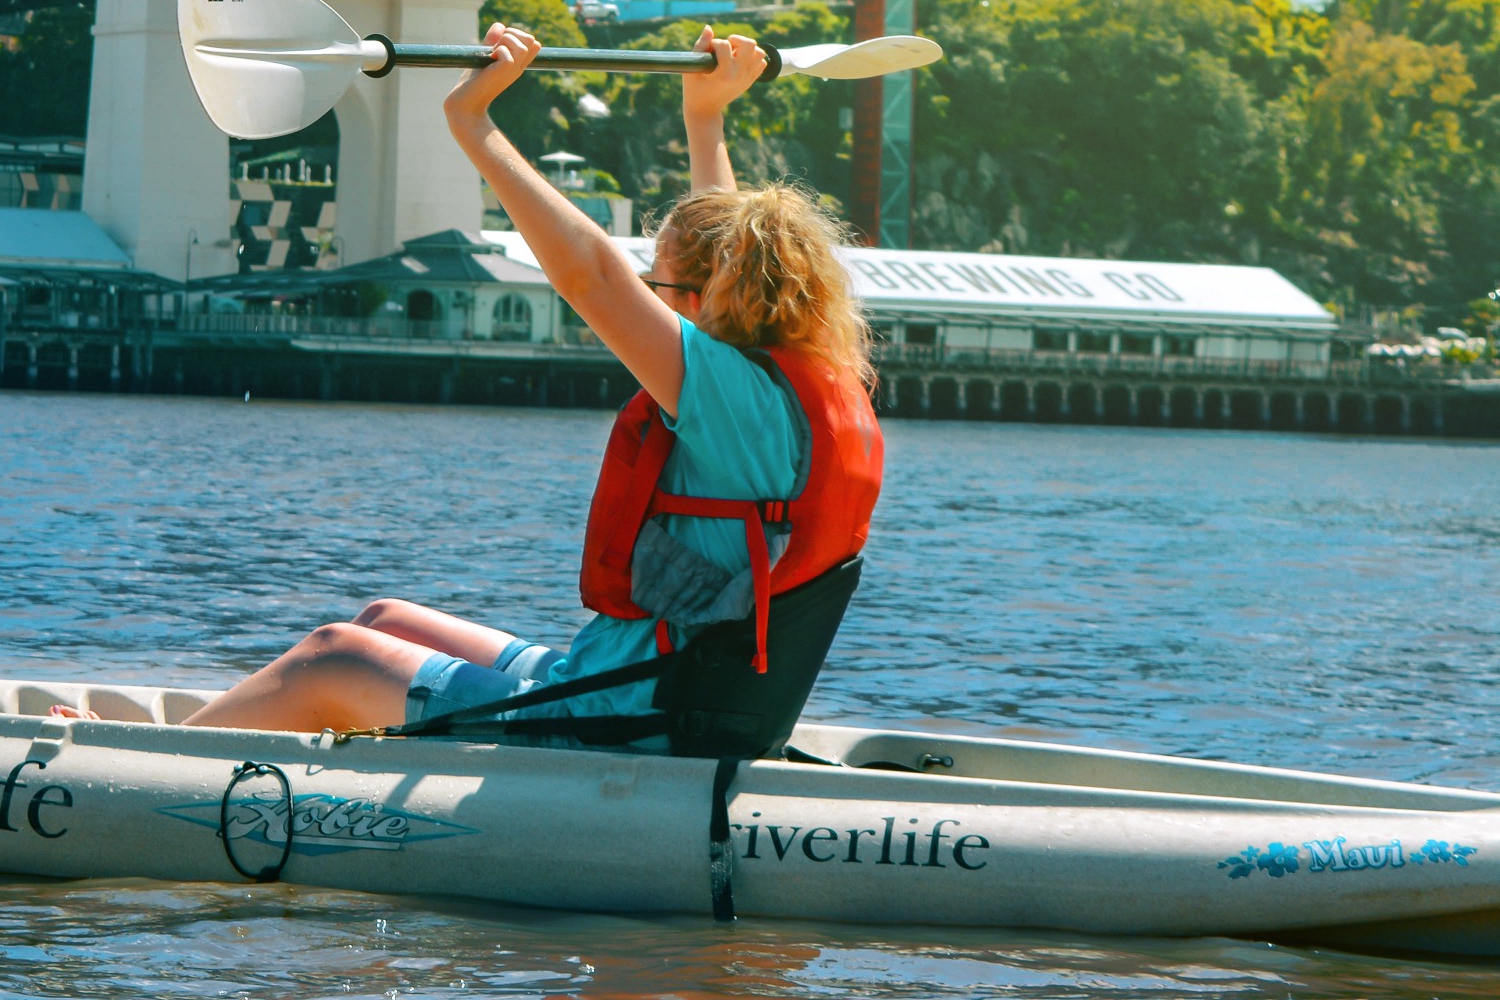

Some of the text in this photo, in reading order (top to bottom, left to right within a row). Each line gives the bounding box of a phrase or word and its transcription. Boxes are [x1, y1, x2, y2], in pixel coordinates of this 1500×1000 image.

[851, 259, 1185, 301] BREWING CO
[216, 791, 410, 847] Hobie
[1303, 836, 1406, 873] Maui
